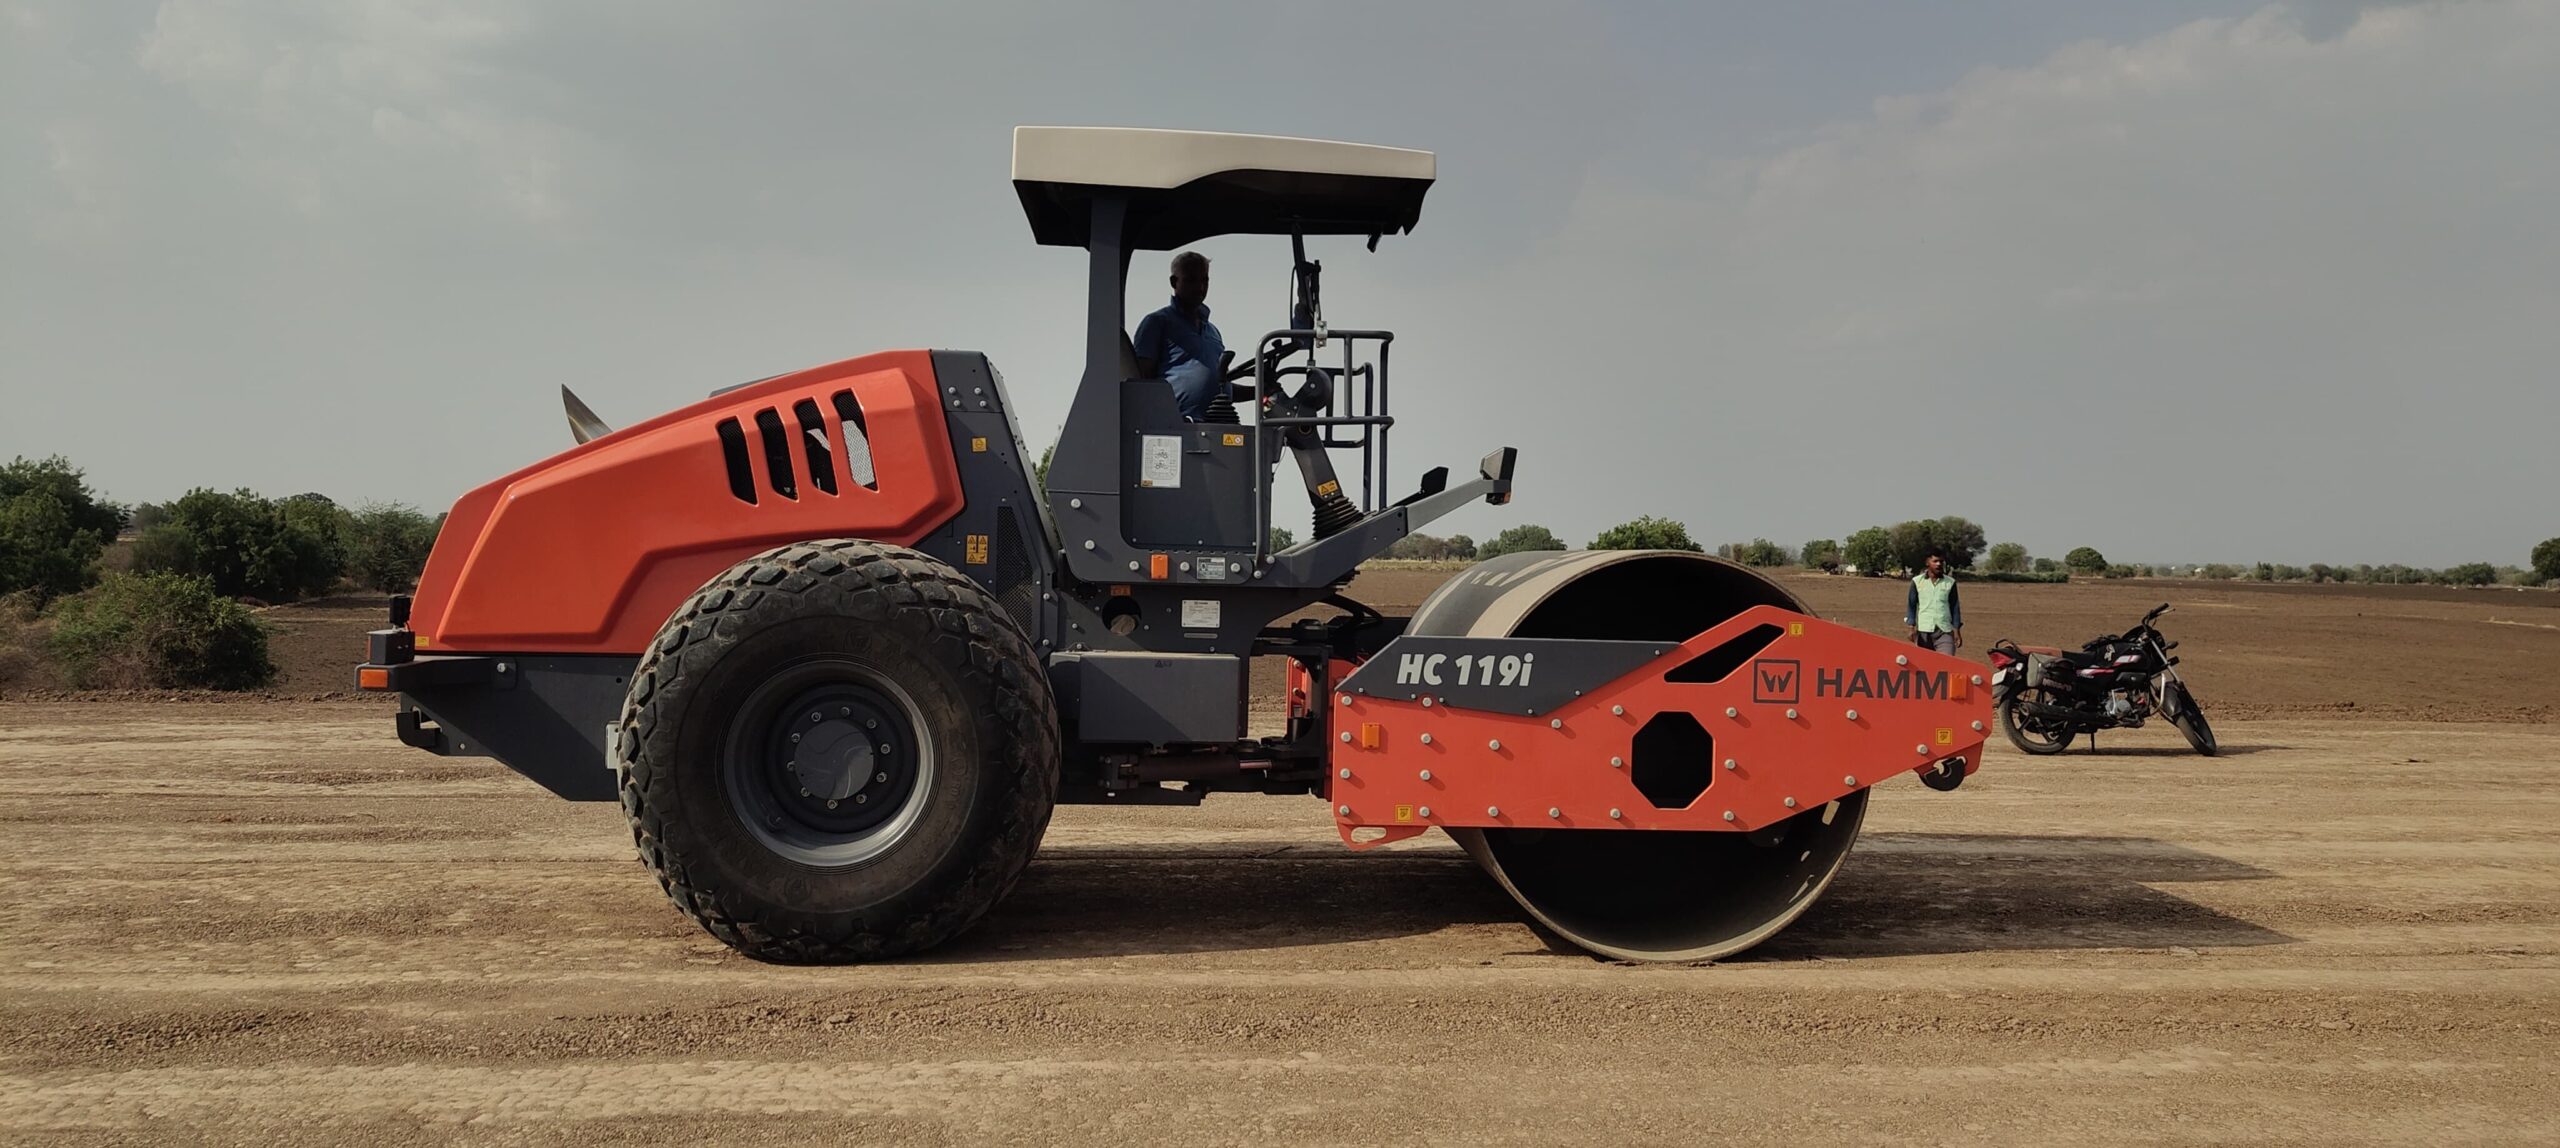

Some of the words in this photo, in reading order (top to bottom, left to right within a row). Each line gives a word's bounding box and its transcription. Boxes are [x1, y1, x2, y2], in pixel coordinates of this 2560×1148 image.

[1396, 653, 1447, 685] HC
[1455, 652, 1534, 687] 119i
[1816, 667, 1949, 700] HAMM
